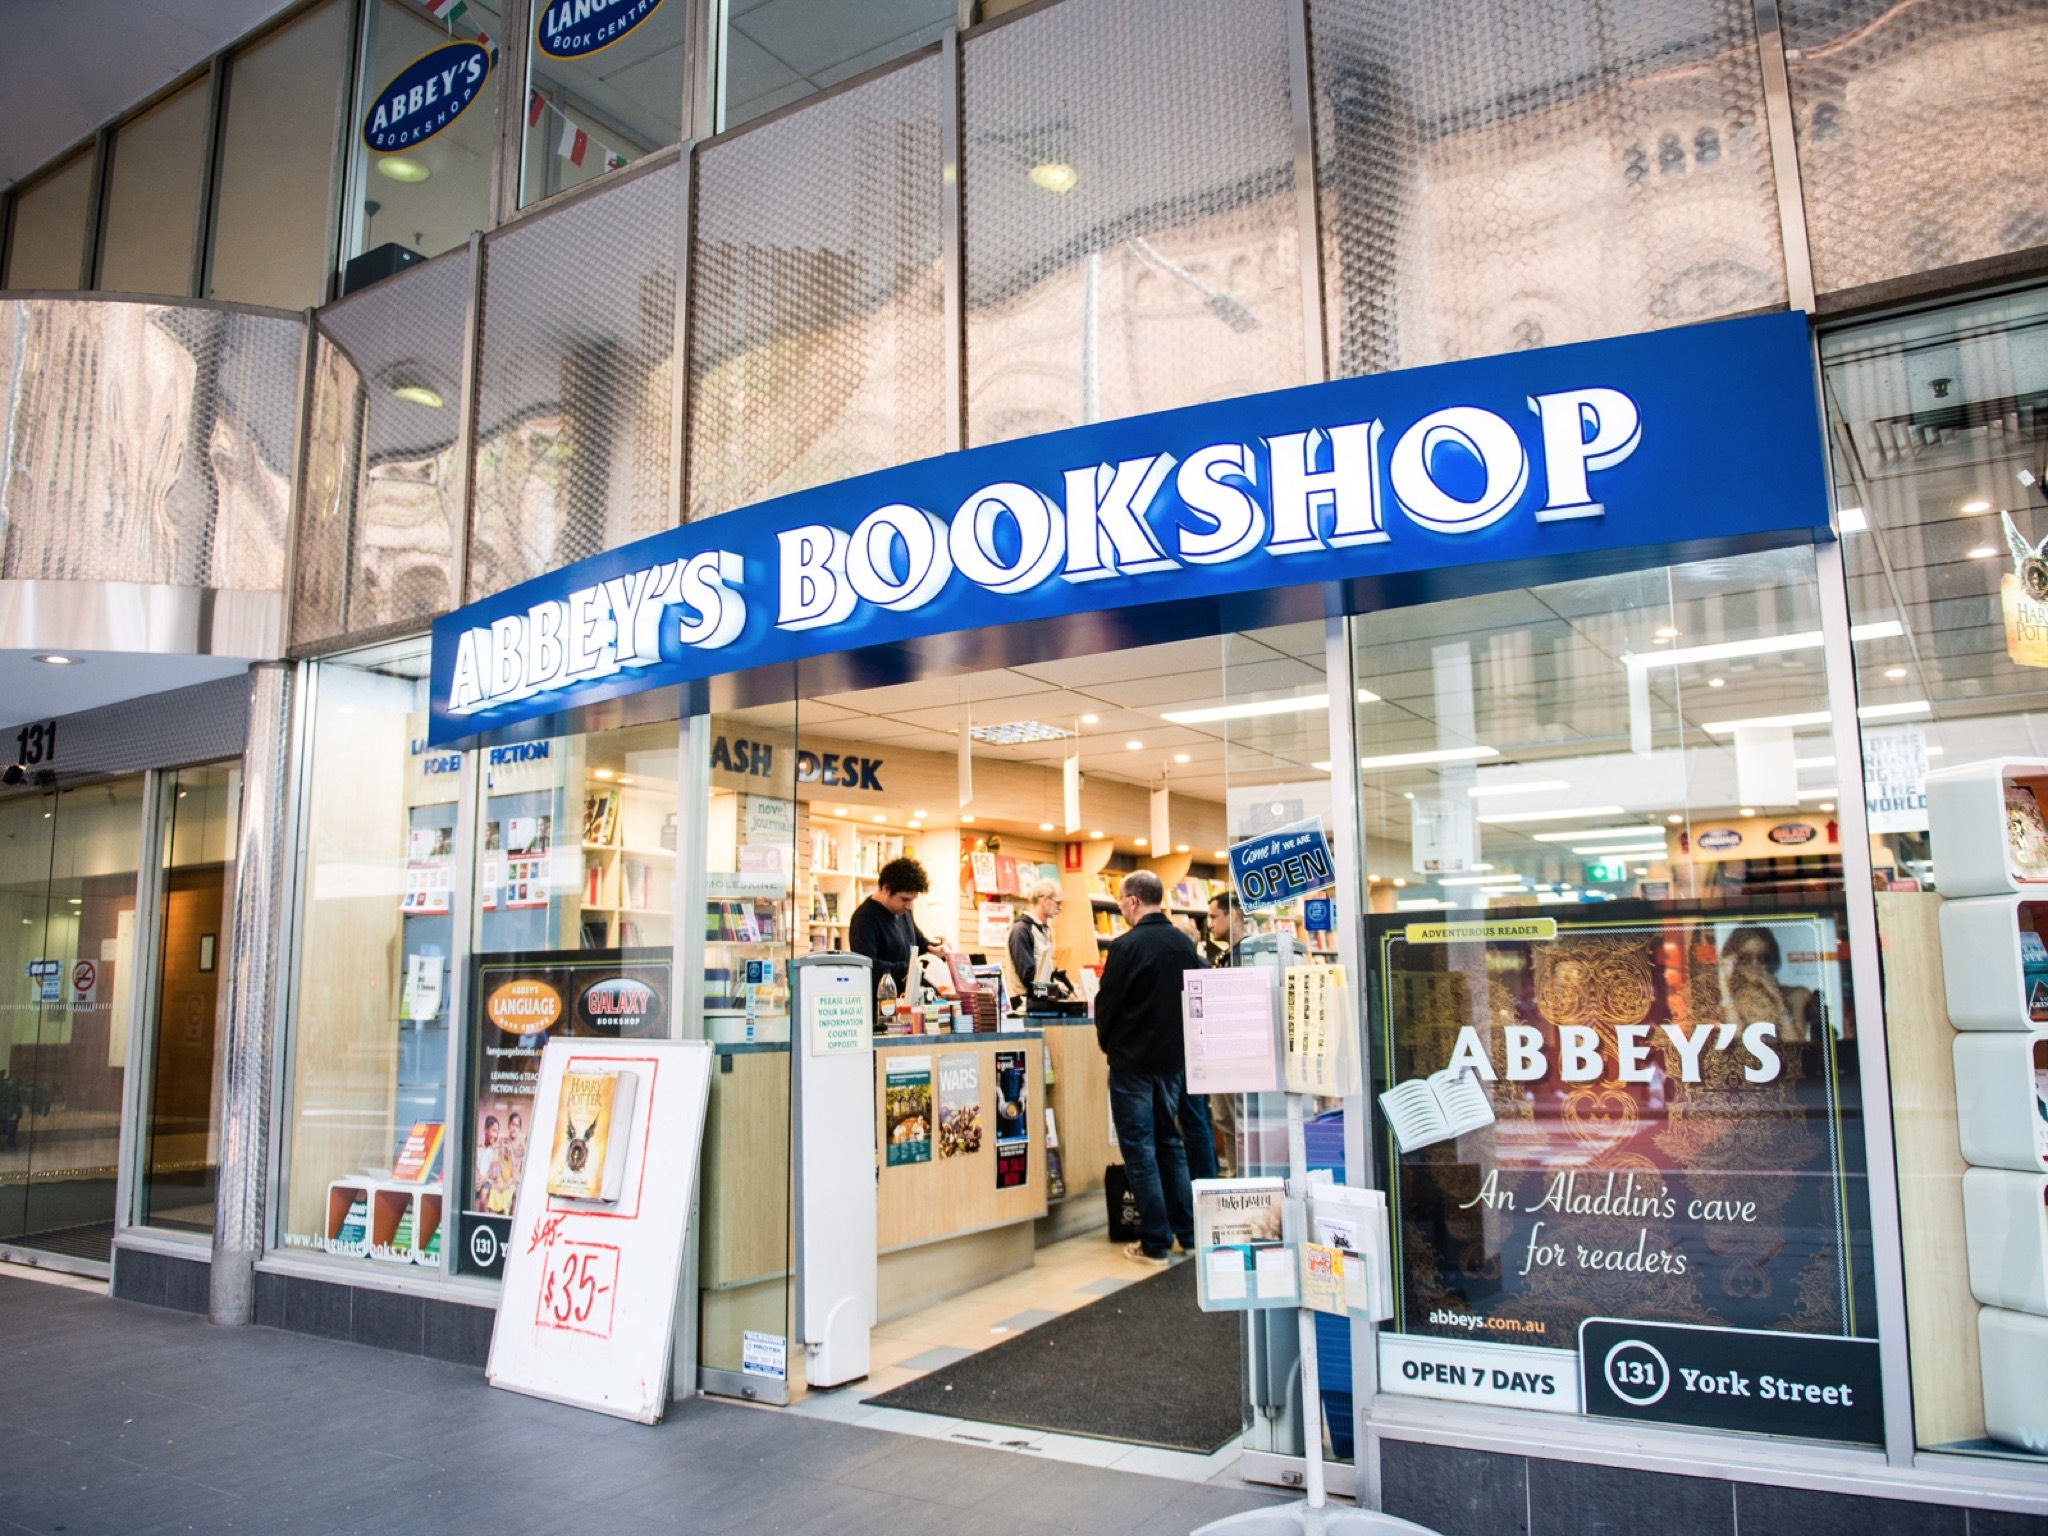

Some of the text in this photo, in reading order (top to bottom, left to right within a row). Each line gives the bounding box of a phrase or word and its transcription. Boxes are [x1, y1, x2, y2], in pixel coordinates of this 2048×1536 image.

[553, 0, 655, 49] BOOK CENTR
[371, 53, 484, 135] ABBEY'S
[376, 87, 473, 146] BOOKSHOP
[447, 386, 1643, 716] ABBEY'S BOOKSHOP
[17, 721, 57, 766] 131
[489, 740, 550, 766] FICTION
[708, 735, 885, 792] ASH DESK
[1241, 834, 1312, 865] Come in WE ARE
[1242, 847, 1330, 900] OPEN
[1421, 925, 1539, 939] ADVENTUROUS READER
[493, 997, 555, 1016] LANGUAGE
[587, 990, 651, 1015] GALAXY
[818, 1008, 838, 1016] YOUR
[819, 996, 843, 1006] PLEASE
[596, 1017, 641, 1026] BOOKSHOP
[818, 1018, 864, 1028] INFORMATION
[827, 1029, 858, 1039] COUNTER
[827, 1040, 859, 1050] OPPOSITE
[1448, 1021, 1781, 1084] ABBEY'S
[571, 1077, 604, 1095] HARRY
[939, 1068, 978, 1092] WARS
[1459, 1168, 1758, 1223] An Aladdin's cave
[475, 1237, 491, 1255] 131
[1519, 1222, 1688, 1276] for readers
[1429, 1310, 1546, 1335] abbeys.com.au
[1401, 1360, 1556, 1396] OPEN 7 DAYS
[1616, 1359, 1854, 1407] 131 York Street
